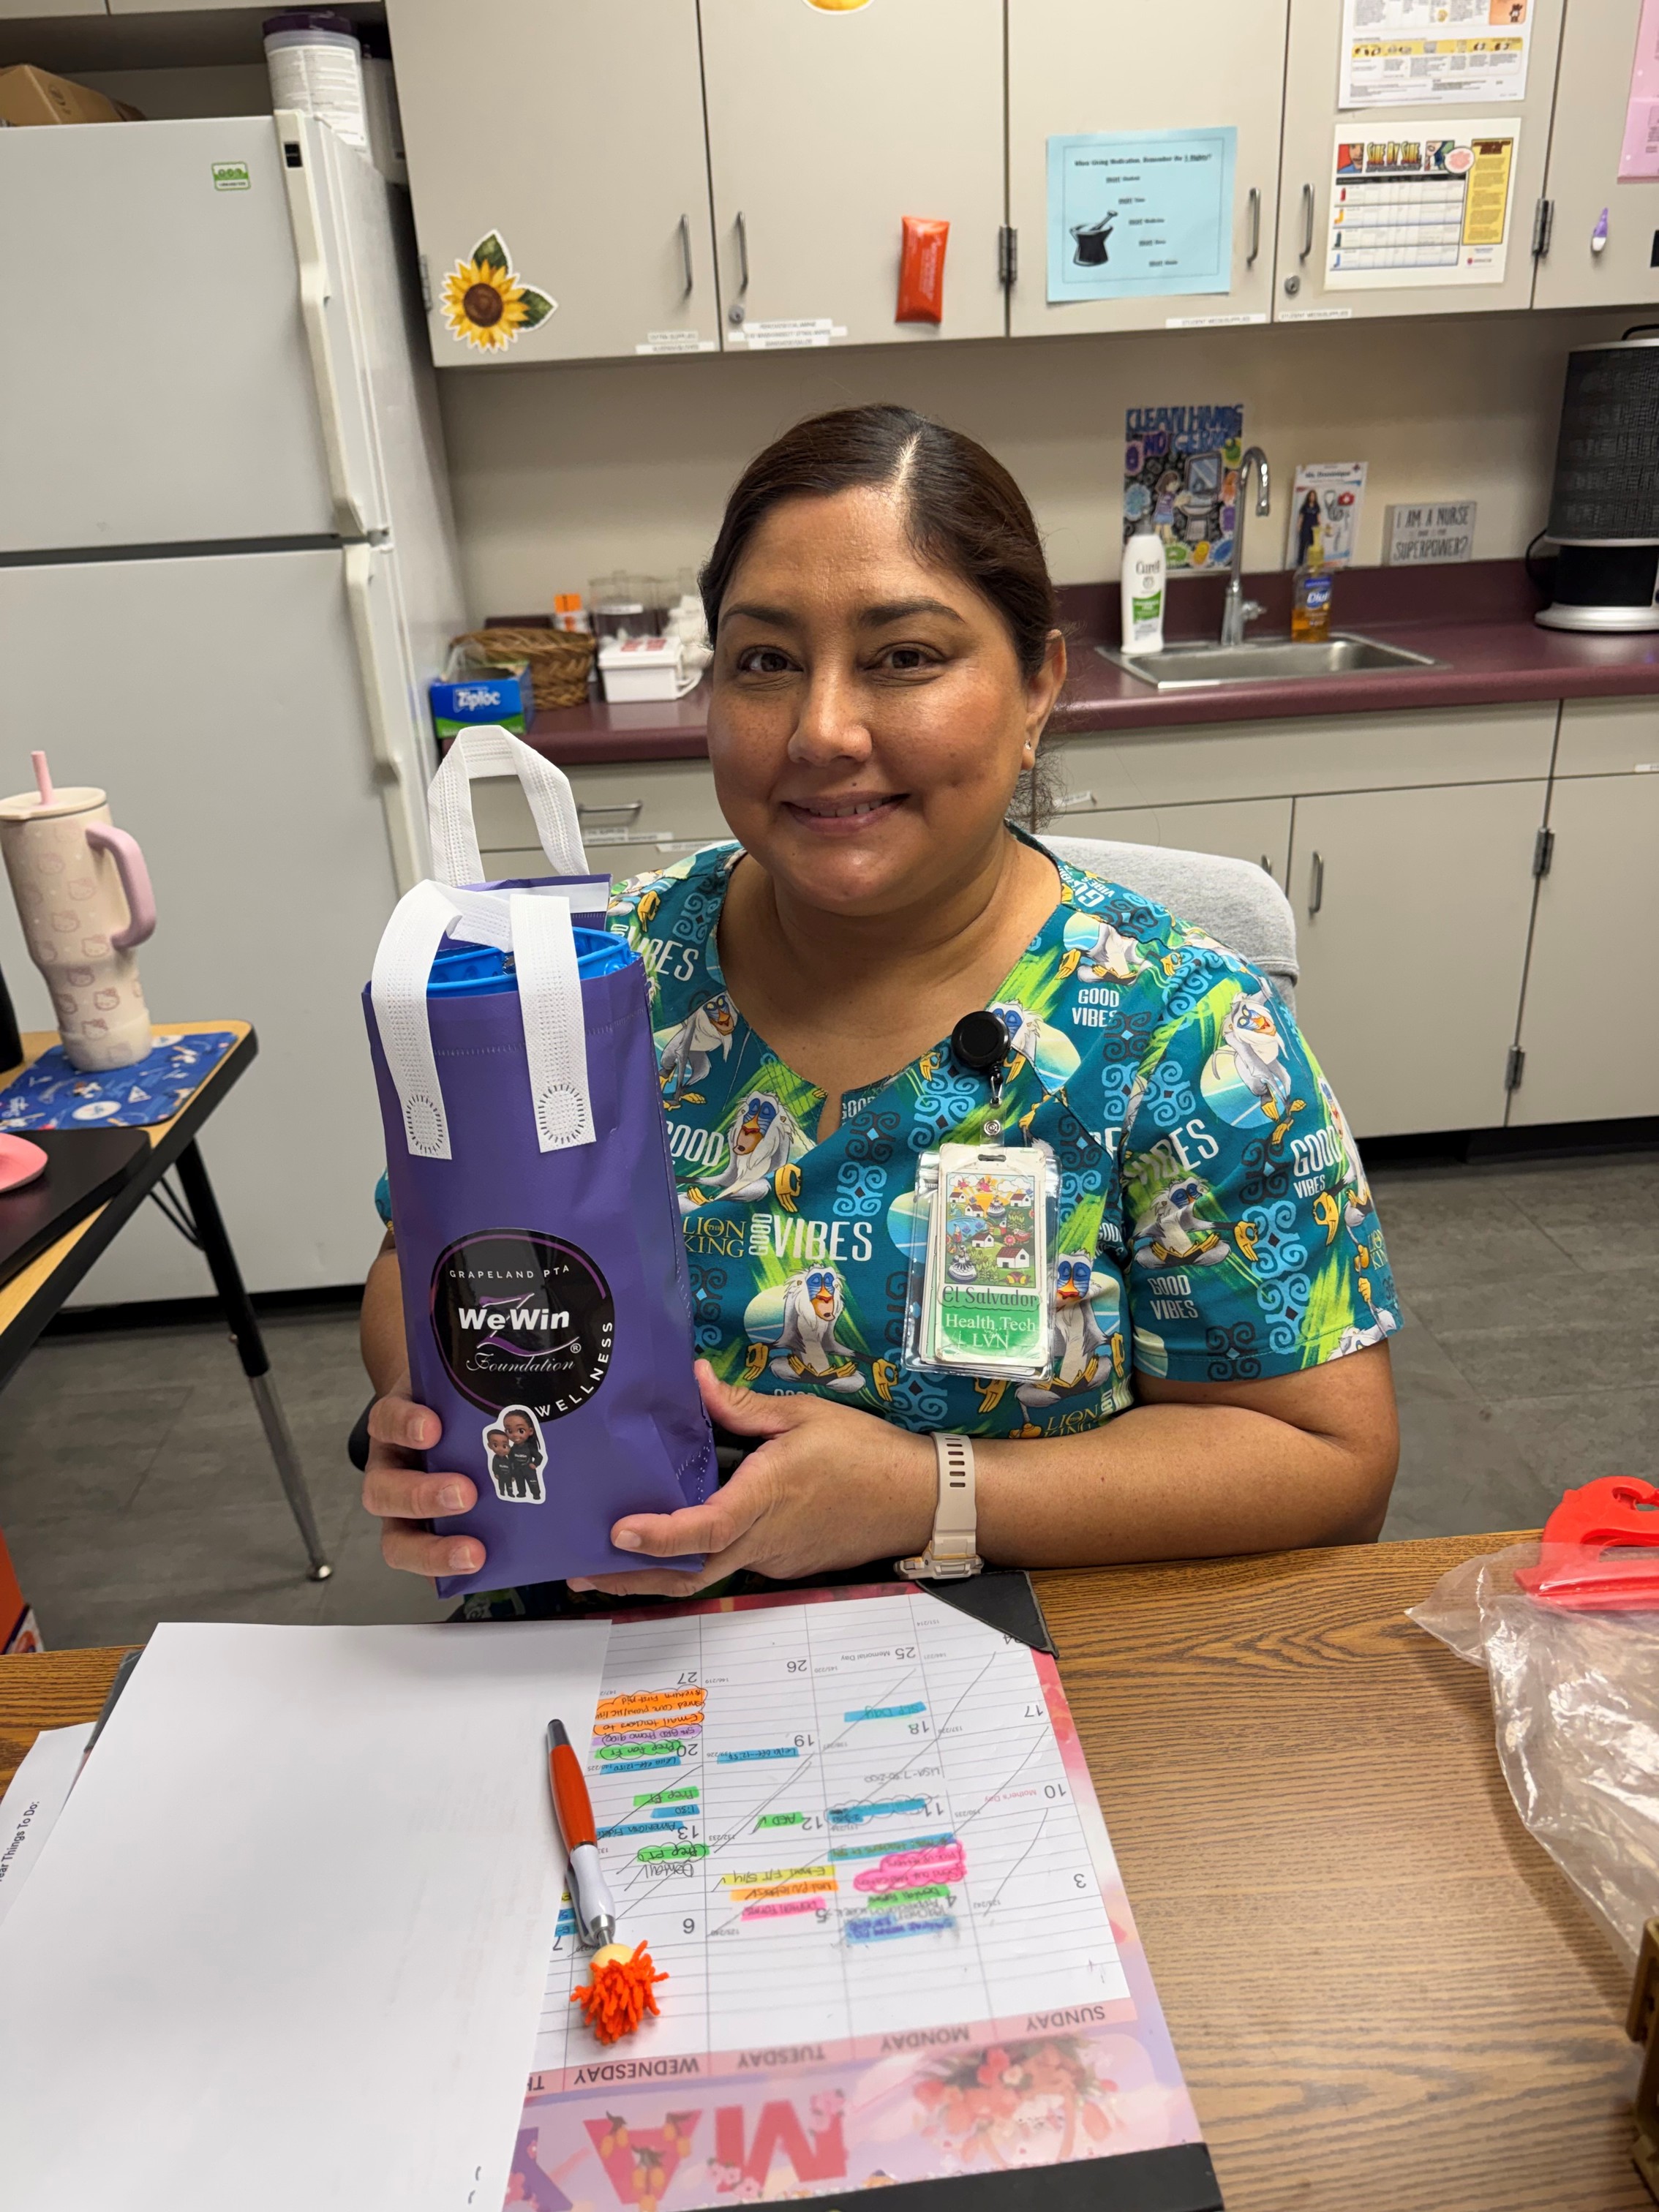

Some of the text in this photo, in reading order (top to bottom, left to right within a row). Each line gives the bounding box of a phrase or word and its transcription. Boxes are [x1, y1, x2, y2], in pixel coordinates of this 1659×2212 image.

[1405, 510, 1421, 527] AM
[1426, 508, 1433, 524] A
[1436, 505, 1470, 526] NURSE
[1393, 536, 1469, 561] SUPERPOWER?
[457, 688, 501, 711] Ziploc
[1078, 988, 1120, 1008] GOOD
[1290, 1125, 1343, 1177] GOOD
[1293, 1175, 1326, 1199] VIBES
[682, 1215, 747, 1239] LION
[749, 1213, 873, 1262] GOOD VIBES
[449, 1264, 570, 1279] GRAPELAND PTA
[1147, 1274, 1192, 1296] GOOD
[942, 1285, 1038, 1309] El Salvador
[458, 1307, 570, 1331] WeWin
[1149, 1298, 1198, 1321] VIBES
[945, 1313, 1037, 1332] Health Tech
[973, 1333, 1009, 1349] LVN
[466, 1352, 576, 1373] Foundation
[534, 1321, 613, 1418] WELLNESS
[917, 1619, 940, 1627] 151/214
[840, 1647, 917, 1662] 25 Memorial Day
[787, 1659, 808, 1674] 26
[677, 1671, 698, 1685] 27
[1024, 1704, 1044, 1718] 17
[908, 1720, 930, 1735] 18
[651, 1742, 675, 1752] Prep
[676, 1743, 698, 1758] 20
[794, 1734, 815, 1748] 19
[983, 1783, 1067, 1803] 10 Mother's Day
[923, 1802, 944, 1818] 11
[771, 1815, 796, 1826] AED
[801, 1816, 824, 1829] 12
[0, 1801, 40, 1882] ear Things To Do:
[677, 1825, 700, 1840] 13
[1073, 1873, 1088, 1889] 3
[945, 1895, 958, 1908] 4
[815, 1908, 827, 1924] 5
[682, 1918, 696, 1935] 6
[552, 1936, 563, 1952] 7
[1025, 2004, 1106, 2031] SUNDAY
[880, 2024, 971, 2052] MONDAY
[737, 2043, 827, 2069] TUESDAY
[573, 2055, 700, 2084] WEDNESDAY
